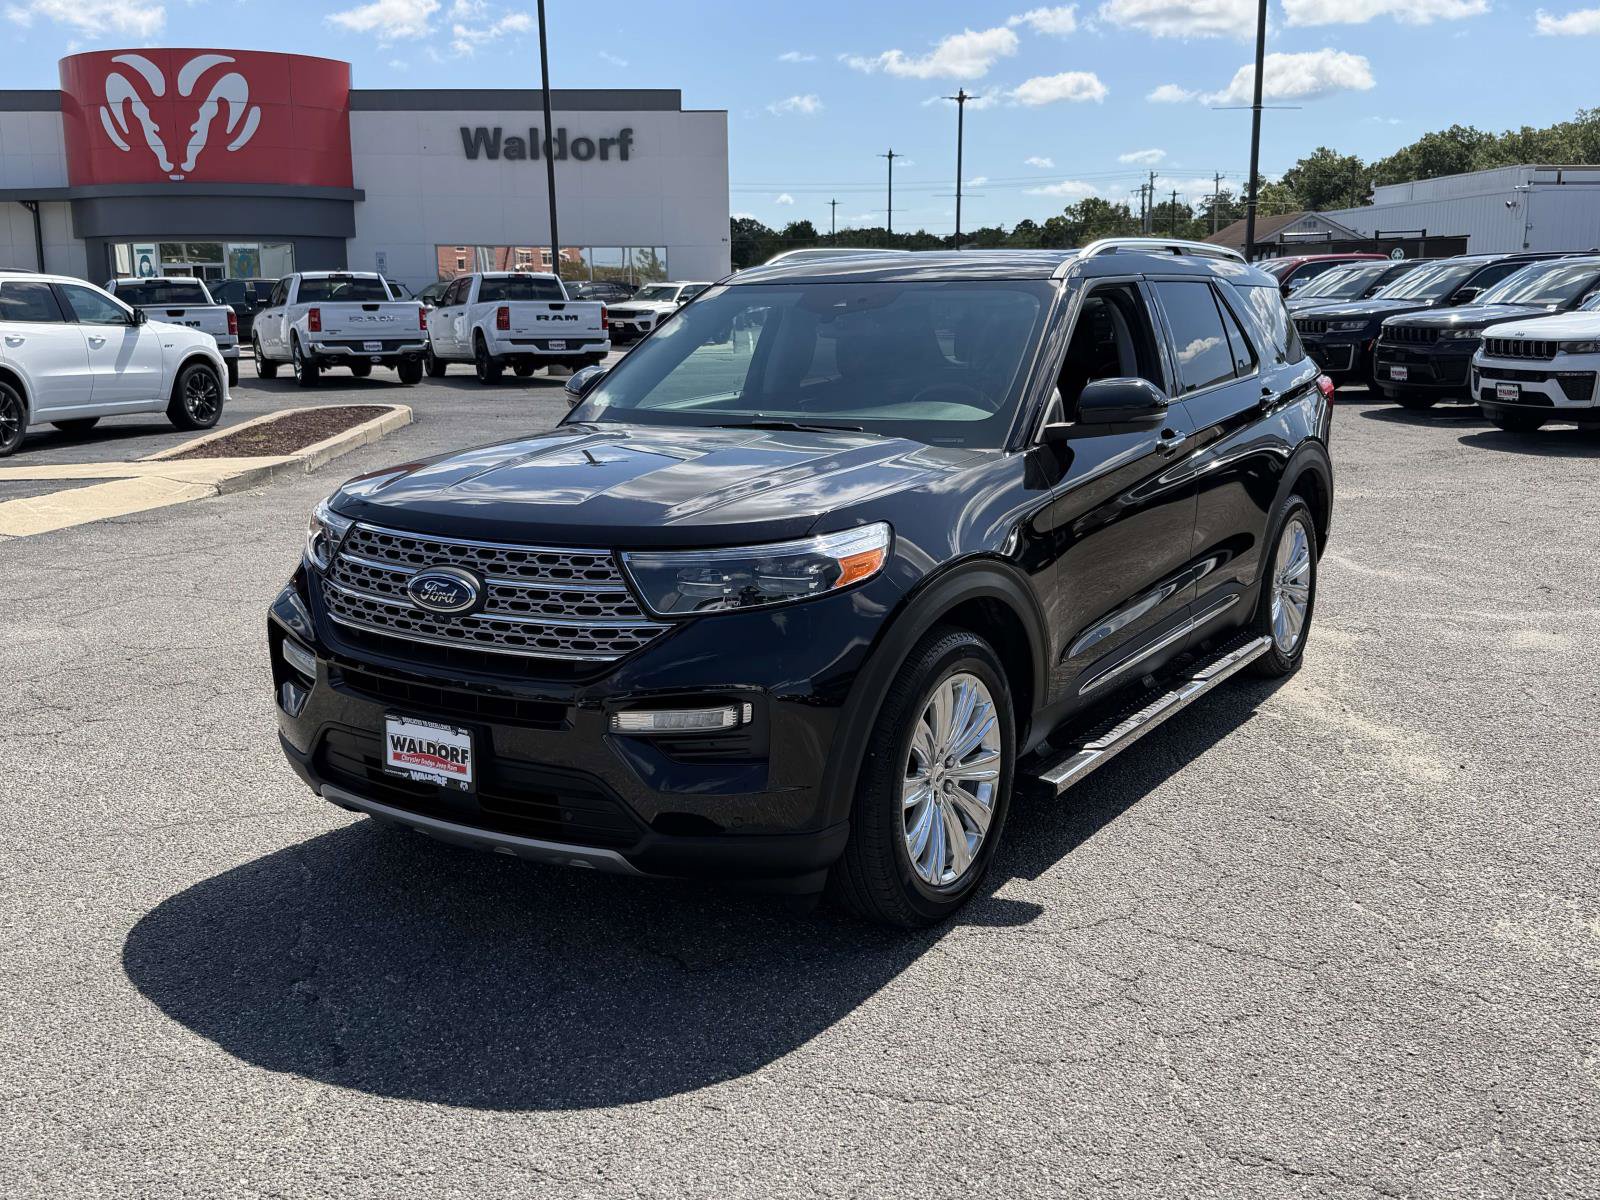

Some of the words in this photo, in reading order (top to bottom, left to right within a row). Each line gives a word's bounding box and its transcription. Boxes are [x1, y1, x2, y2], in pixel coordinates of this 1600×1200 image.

[459, 127, 634, 161] Waldorf
[420, 580, 458, 604] Ford
[390, 735, 469, 764] WALDORF
[402, 755, 421, 765] Chrysler
[447, 763, 458, 772] Ram
[410, 771, 447, 786] WALDORF
